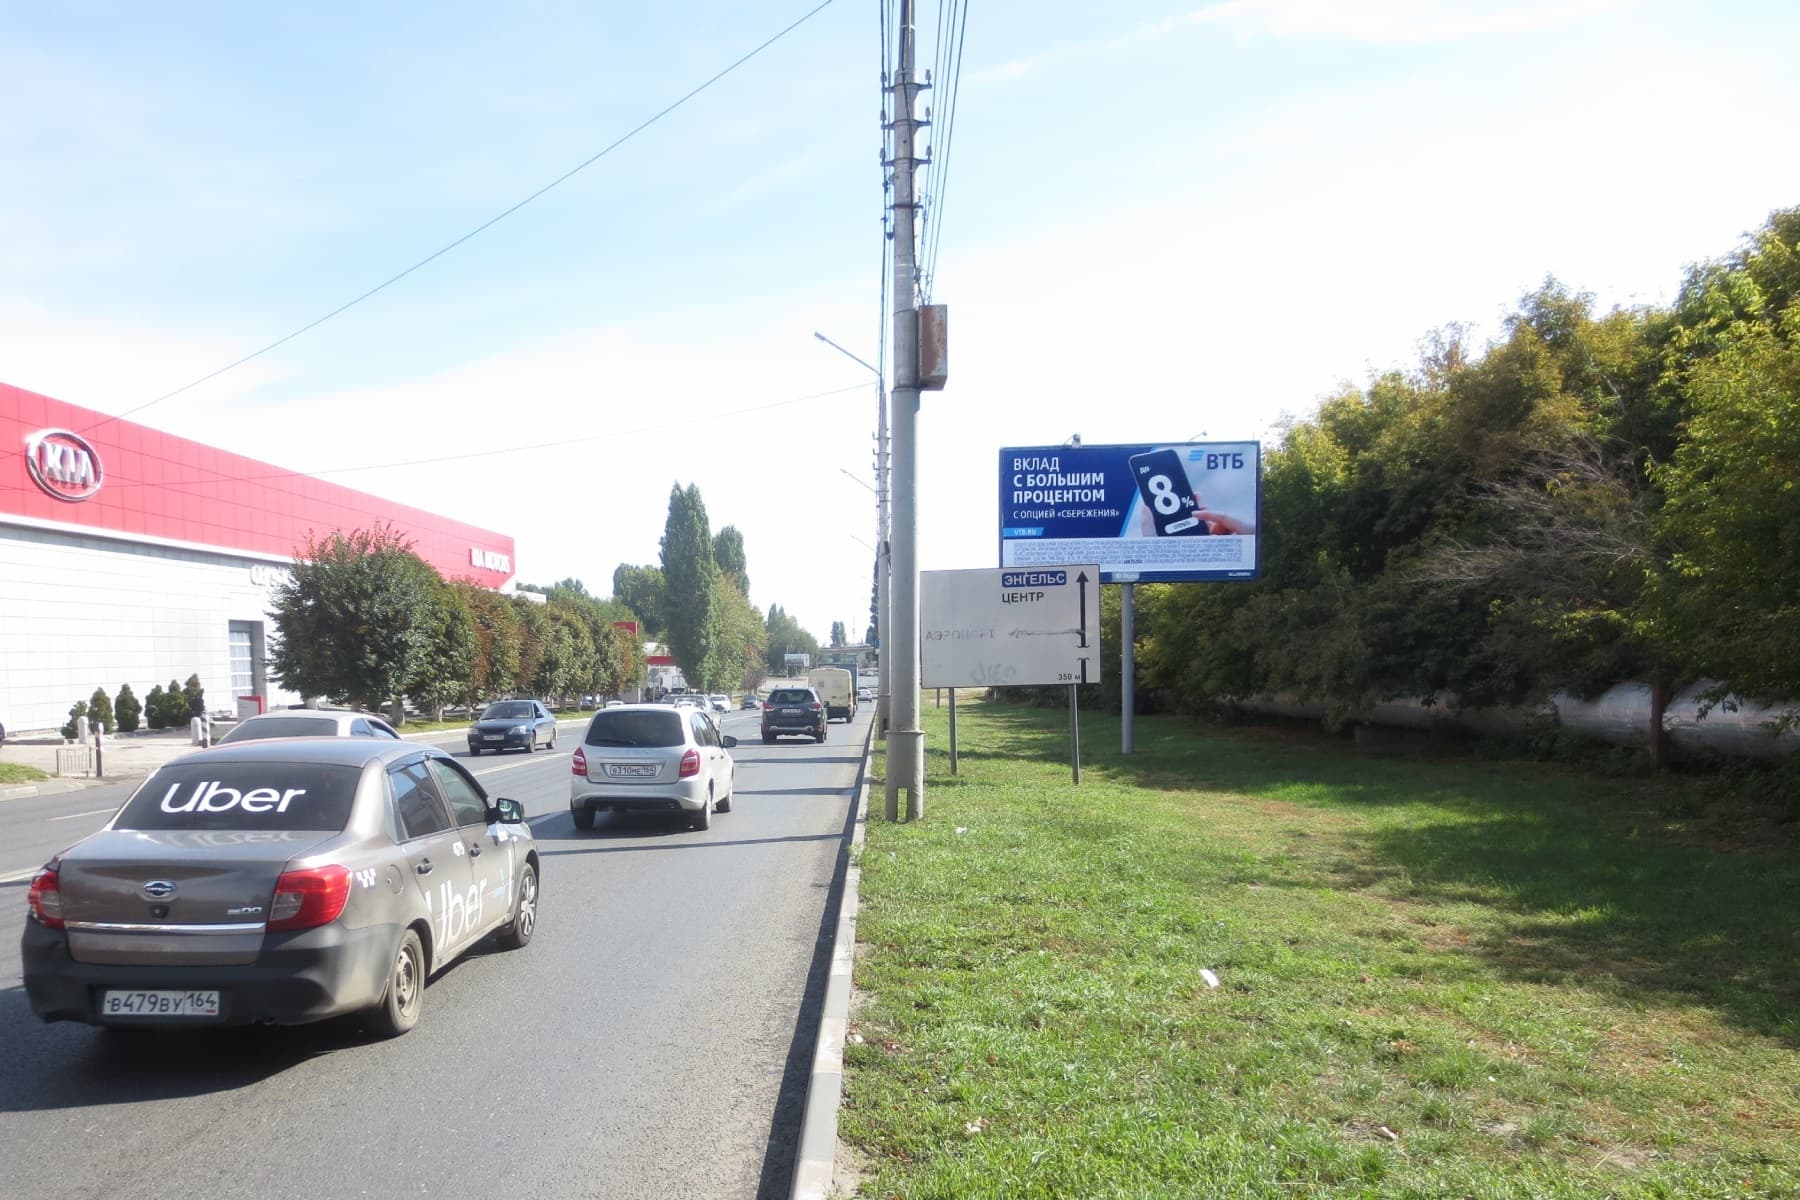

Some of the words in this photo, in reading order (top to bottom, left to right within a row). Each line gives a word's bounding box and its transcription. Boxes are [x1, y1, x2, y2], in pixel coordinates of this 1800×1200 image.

[1014, 457, 1060, 472] ВКЛАД
[1207, 453, 1244, 470] ВТБ
[1013, 474, 1023, 487] С
[1027, 473, 1105, 487] БОЛЬШИМ
[1013, 489, 1105, 505] ПРОЦЕНТОМ
[1013, 510, 1019, 519] С
[1020, 509, 1056, 520] ОПЦИЕЙ
[1057, 508, 1120, 518] «СБЕРЕЖЕНИЯ»
[1004, 573, 1065, 586] ЭНГЕЛЬС
[1002, 592, 1045, 604] ЦЕНТР
[1058, 673, 1073, 681] 350
[160, 781, 307, 813] Uber
[110, 993, 183, 1012] В479ВУ
[187, 993, 217, 1008] 164
